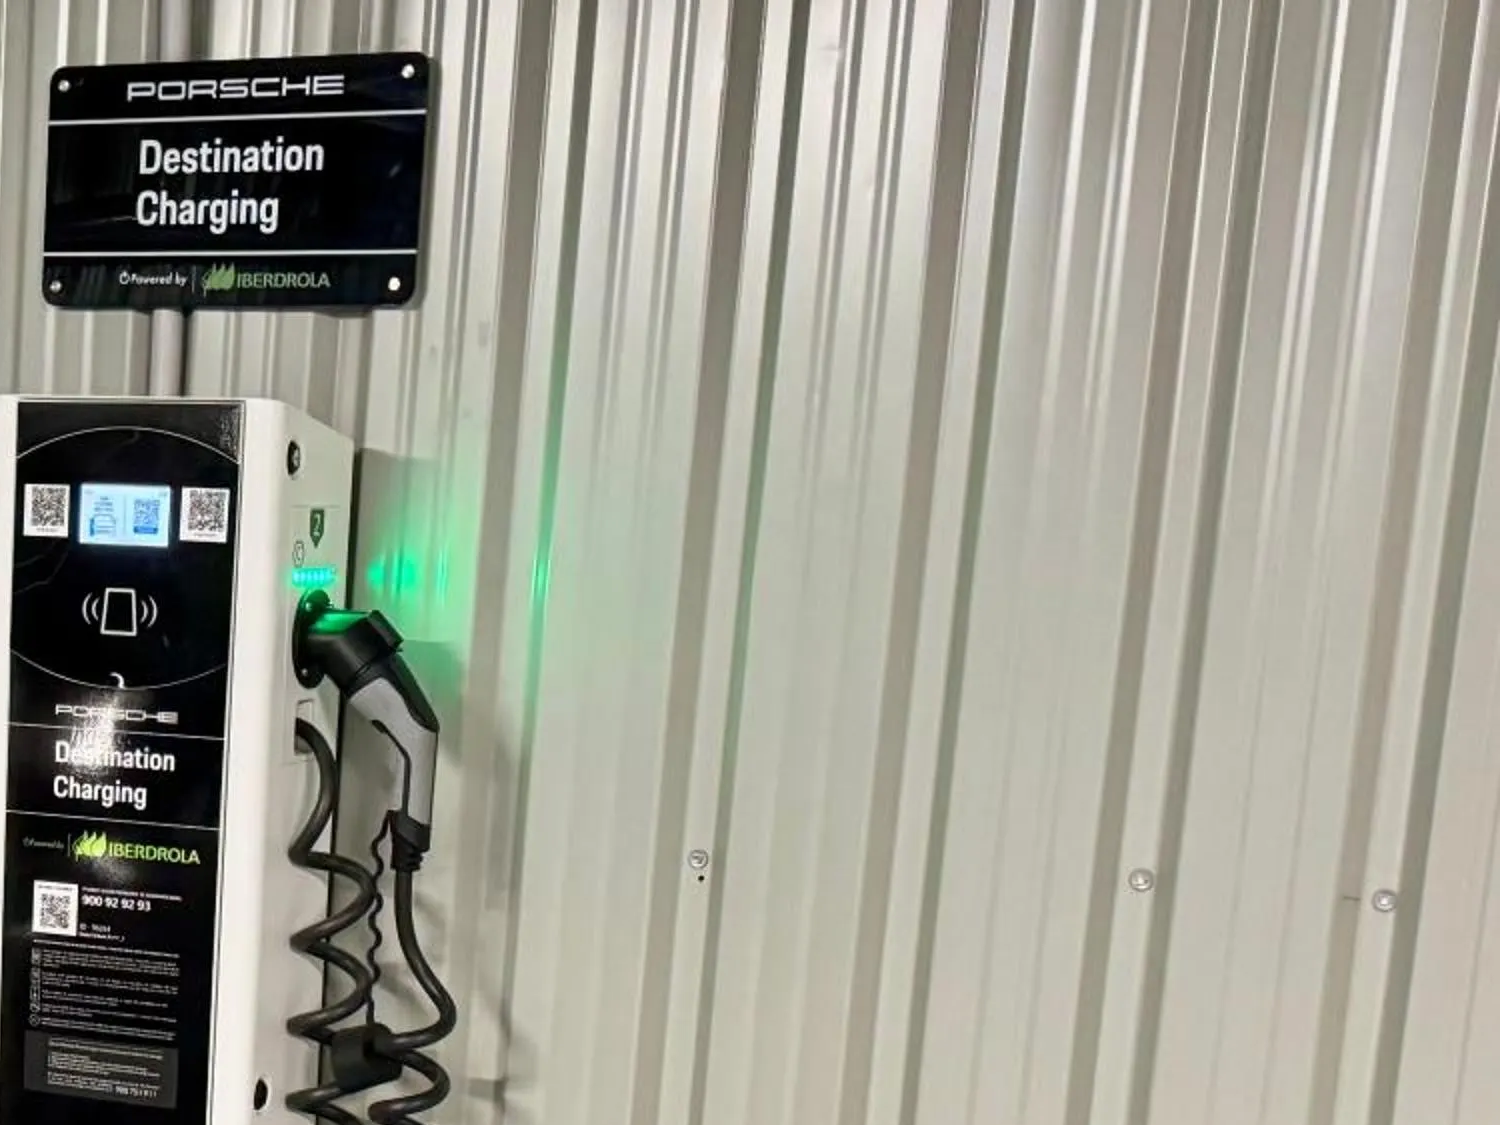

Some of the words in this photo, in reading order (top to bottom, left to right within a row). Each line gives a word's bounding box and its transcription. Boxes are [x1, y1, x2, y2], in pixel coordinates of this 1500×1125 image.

[126, 74, 345, 102] PORSCHE
[138, 135, 325, 175] Destination
[136, 189, 280, 235] Charging
[131, 272, 172, 286] Powered
[174, 271, 188, 288] by
[237, 271, 331, 289] IBERDROLA
[53, 776, 148, 811] Charging
[108, 841, 201, 865] IBERDROLA
[82, 894, 103, 907] 900
[105, 896, 119, 909] 92
[121, 898, 135, 911] 92
[137, 900, 151, 912] 93
